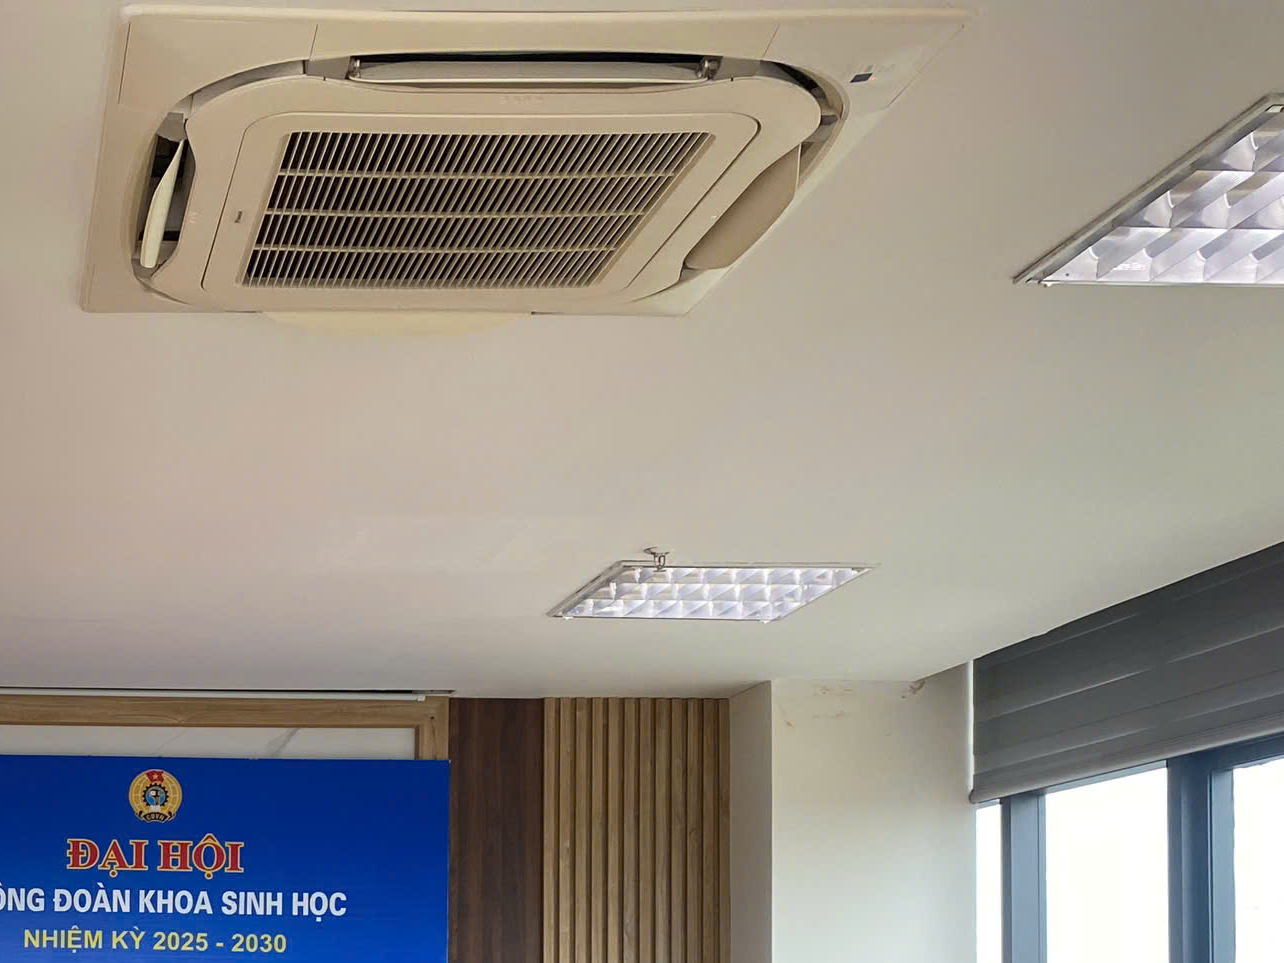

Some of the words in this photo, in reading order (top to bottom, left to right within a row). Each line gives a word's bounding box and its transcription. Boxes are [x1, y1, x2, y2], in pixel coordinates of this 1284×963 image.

[66, 838, 148, 878] ĐẠI
[157, 833, 244, 880] HỘI
[53, 882, 130, 913] ĐOÀN
[139, 889, 213, 914] KHOA
[221, 891, 283, 915] SINH
[292, 892, 347, 922] HỌC
[23, 925, 103, 953] NHIỆM
[111, 926, 146, 950] KỲ
[153, 931, 208, 951] 2025
[231, 933, 287, 953] 2030
